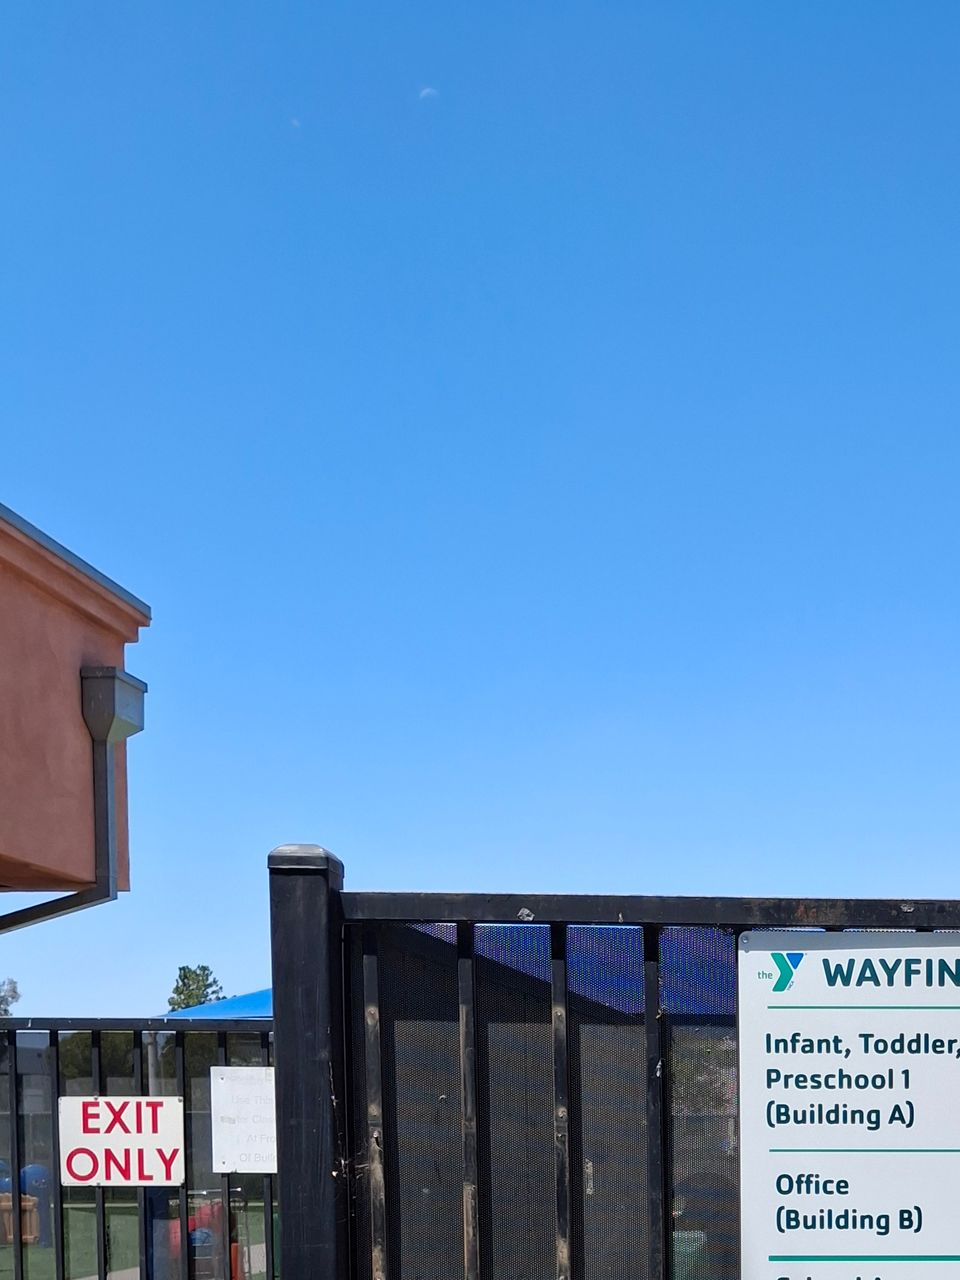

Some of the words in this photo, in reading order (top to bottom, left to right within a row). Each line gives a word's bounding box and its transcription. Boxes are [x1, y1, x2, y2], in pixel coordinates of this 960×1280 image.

[758, 971, 772, 979] the
[766, 1033, 851, 1058] Infant,
[767, 1069, 893, 1089] Preschool
[902, 1069, 909, 1089] 1
[82, 1101, 163, 1133] EXIT
[767, 1100, 880, 1130] (Building
[888, 1101, 914, 1128] A)
[66, 1148, 179, 1181] ONLY
[776, 1174, 849, 1195] Office
[777, 1206, 889, 1235] (Building
[899, 1206, 922, 1233] B)
